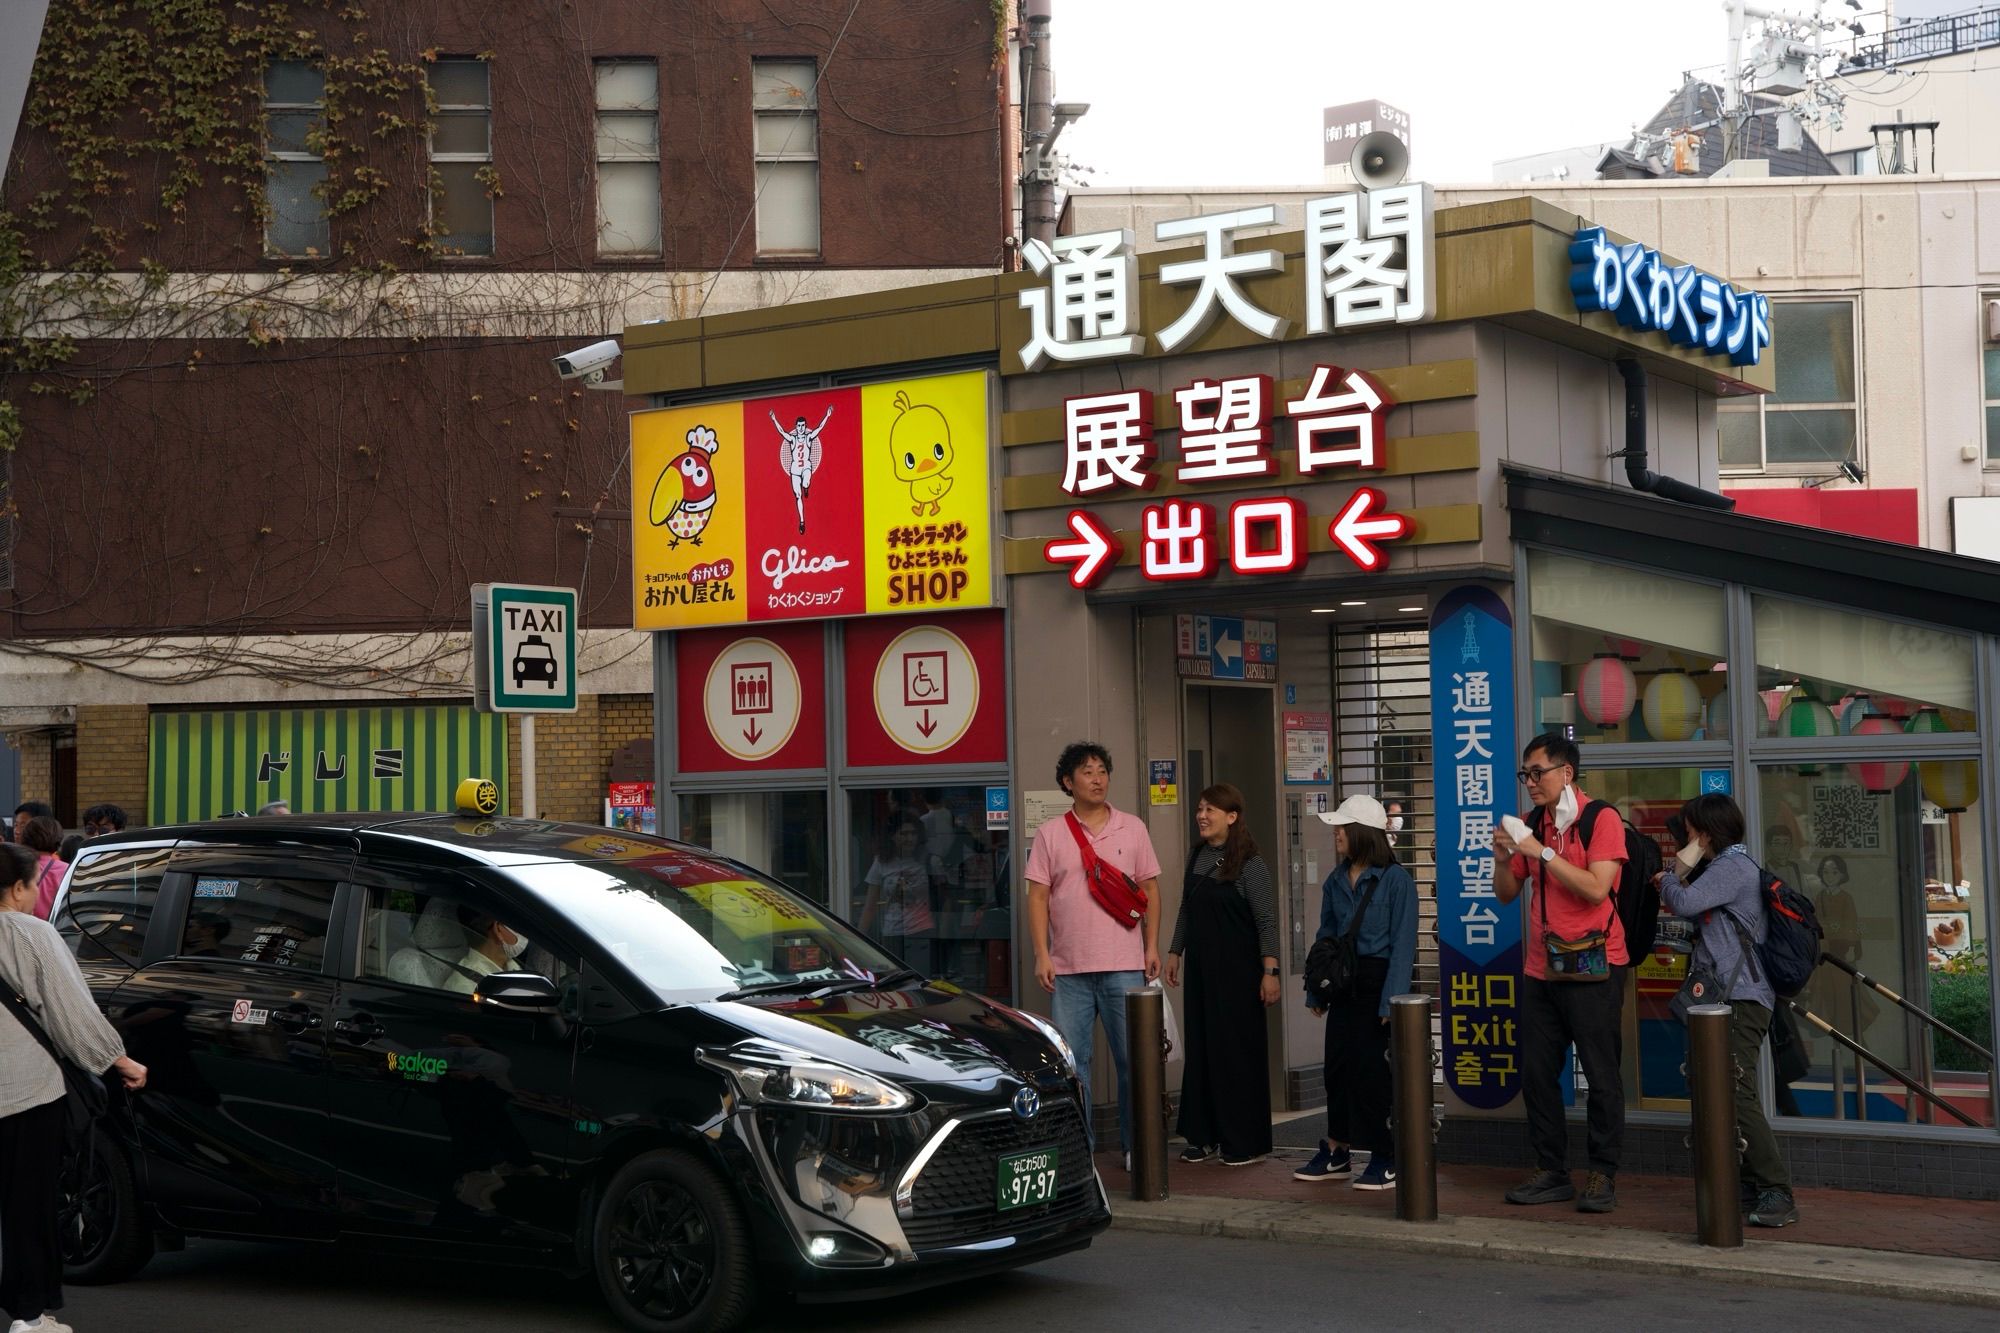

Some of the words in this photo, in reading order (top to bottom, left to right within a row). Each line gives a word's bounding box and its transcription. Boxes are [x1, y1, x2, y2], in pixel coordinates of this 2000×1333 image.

[1018, 182, 1432, 371] 通天閣
[1589, 226, 1770, 365] わくわくランド
[1061, 365, 1388, 494] 展望台
[887, 523, 968, 547] チキンラーメン
[1144, 500, 1300, 578] 出口
[887, 549, 968, 571] ひよこちゃん
[644, 572, 689, 583] キョロちゃんの
[889, 572, 968, 603] SHOP
[644, 583, 736, 609] おかし屋さん
[768, 587, 845, 610] わくわくショップ
[504, 607, 563, 633] TAXI
[257, 748, 404, 783] ドレミ
[615, 794, 642, 804] チェリオ
[1450, 671, 1500, 945] 通天閣展望台
[1450, 971, 1516, 1008] 出口
[1452, 1015, 1517, 1046] Exit
[398, 1051, 449, 1075] sakae
[1454, 1052, 1518, 1087] 출구
[1002, 1188, 1011, 1199] い
[1011, 1169, 1056, 1205] 97-97
